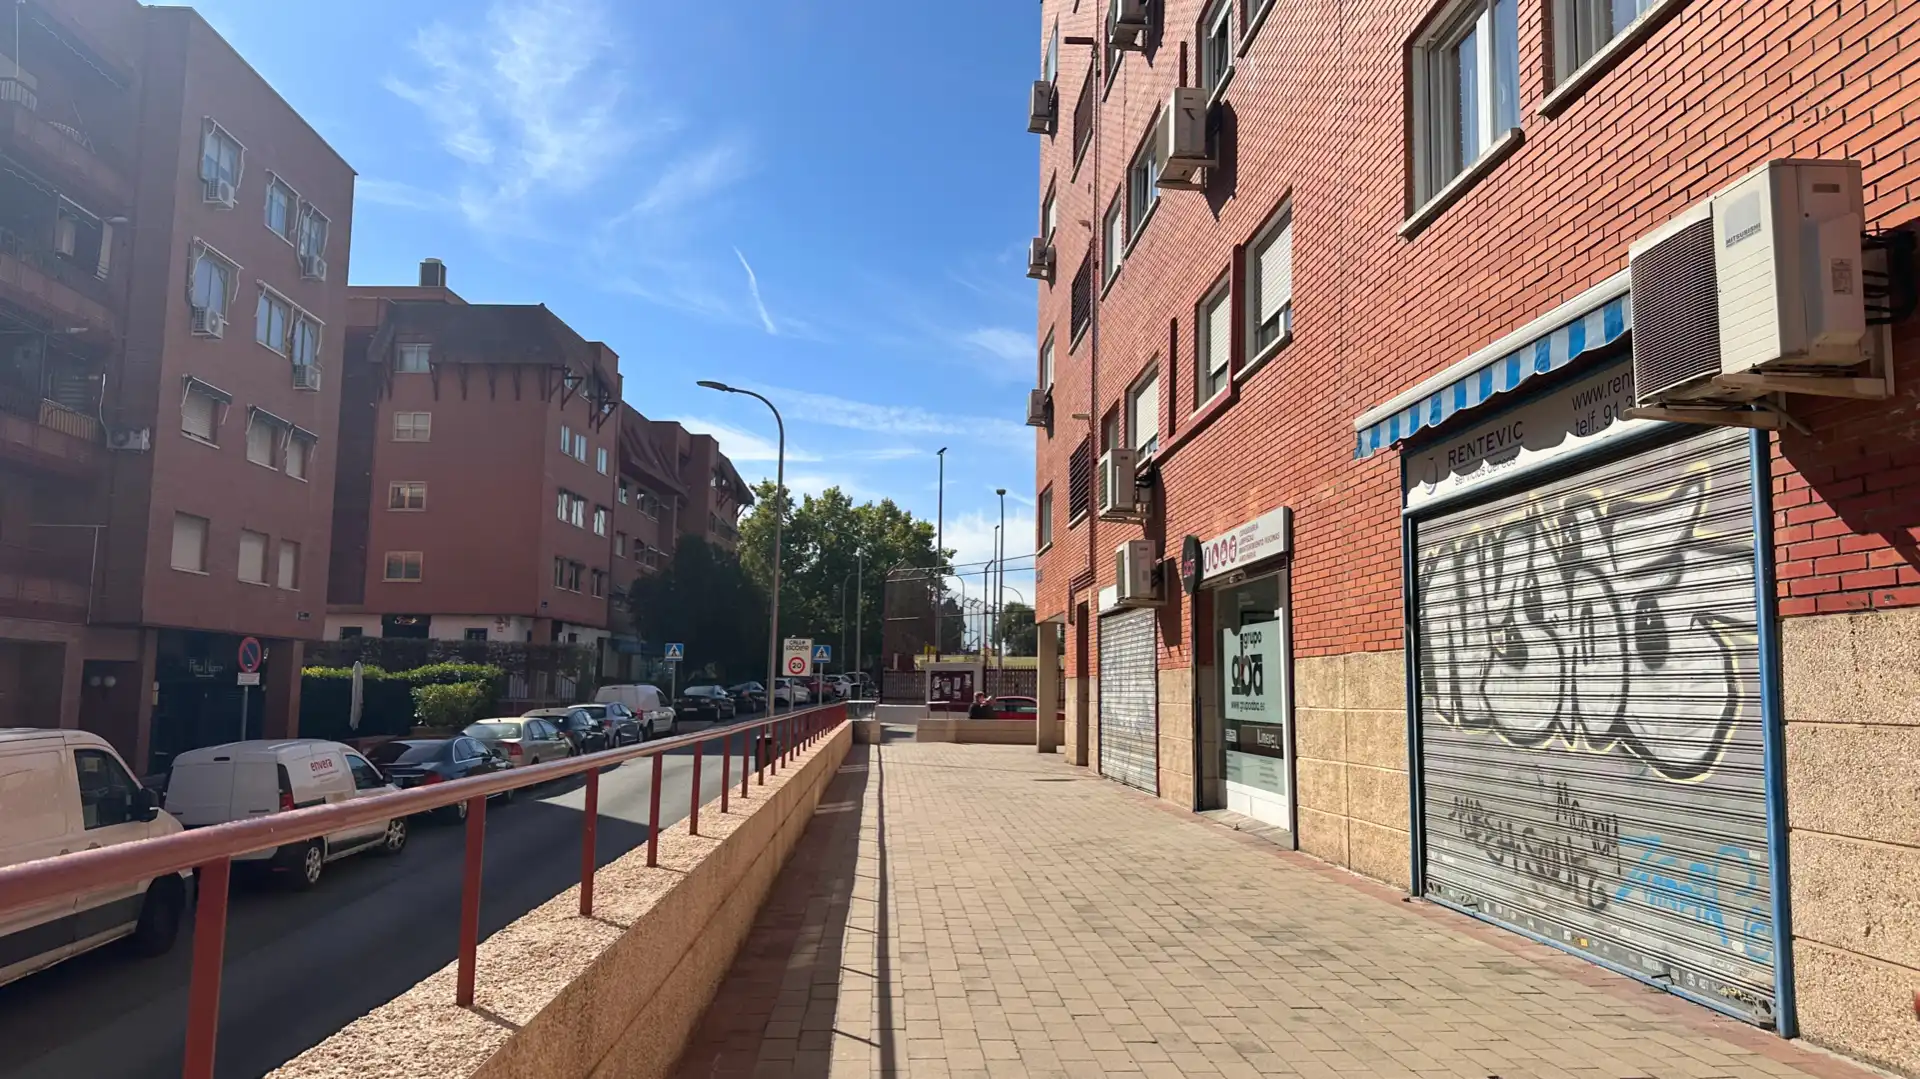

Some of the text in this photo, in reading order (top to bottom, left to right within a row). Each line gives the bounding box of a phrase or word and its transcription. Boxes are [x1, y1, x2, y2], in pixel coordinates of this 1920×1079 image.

[1725, 222, 1761, 245] MITSUBISHI
[1575, 409, 1599, 437] telf.
[1603, 401, 1620, 426] 91
[1447, 421, 1524, 468] RENTEVIC
[1243, 631, 1262, 649] grupo
[310, 758, 333, 772] envera
